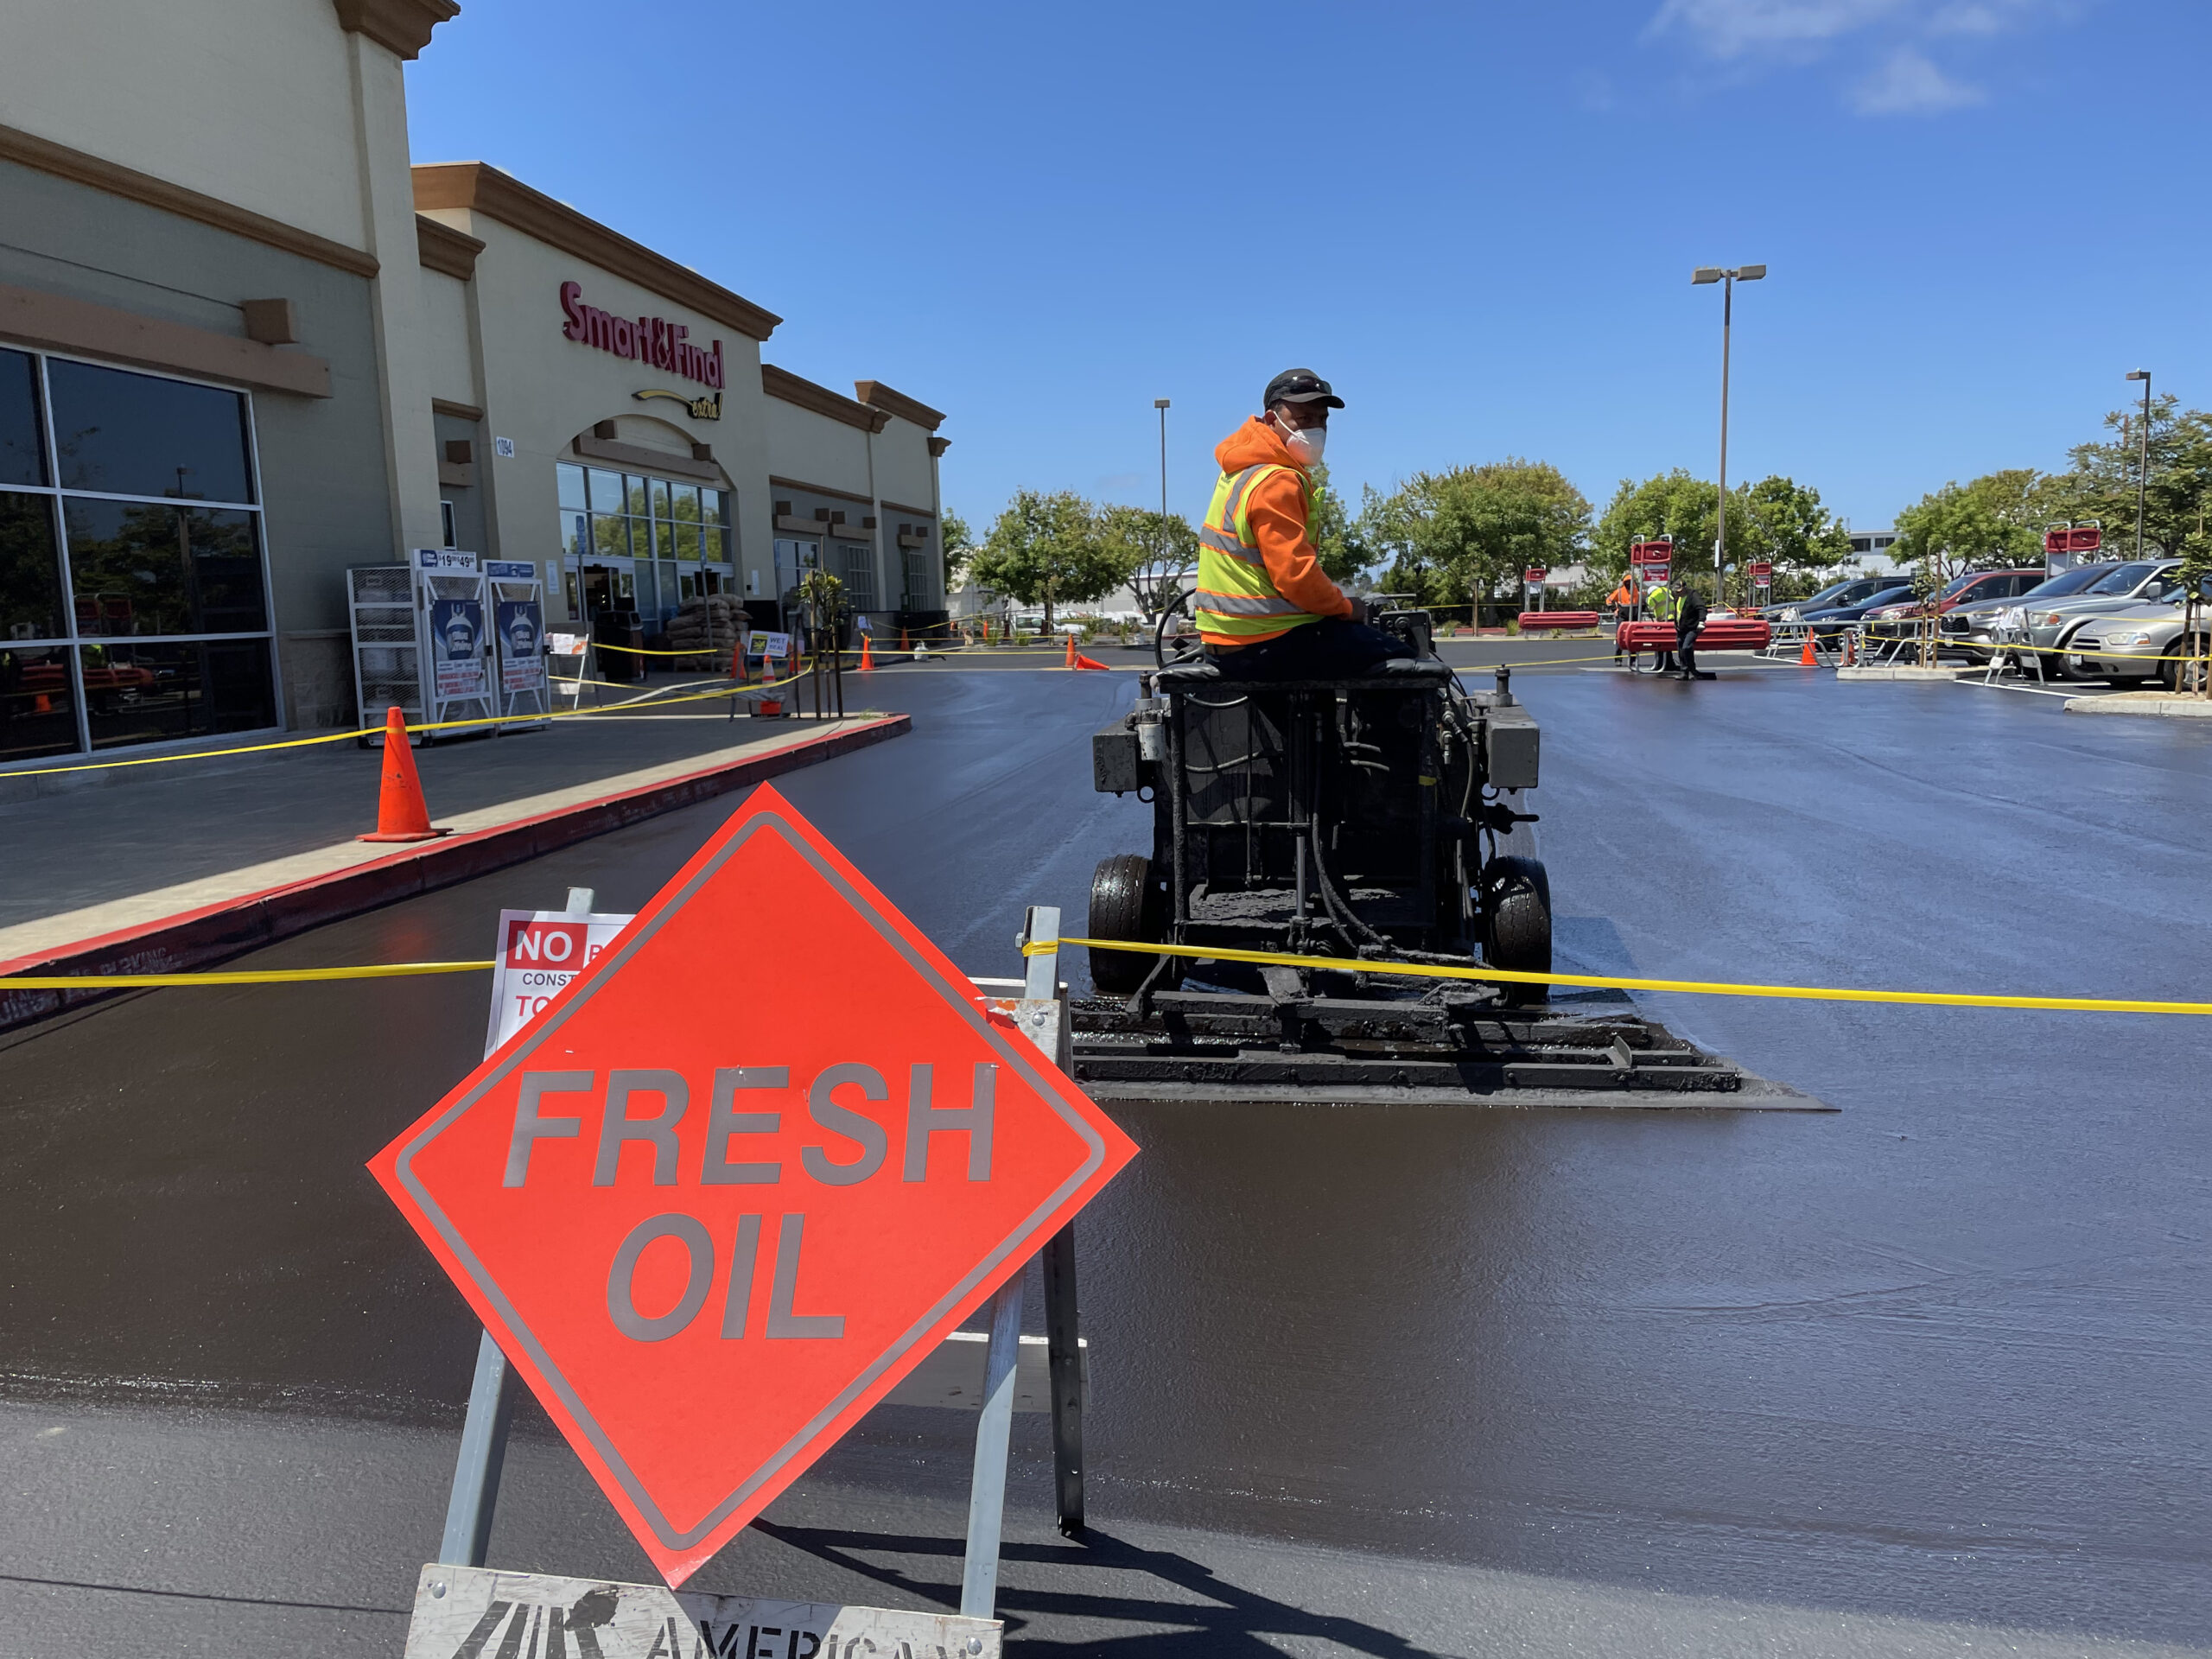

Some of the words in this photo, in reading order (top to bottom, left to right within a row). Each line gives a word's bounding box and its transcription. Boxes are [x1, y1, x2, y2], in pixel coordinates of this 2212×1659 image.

[515, 930, 573, 962] NO
[501, 1061, 998, 1188] FRESH
[606, 1211, 847, 1343] OIL
[646, 1617, 968, 1659] AMER
